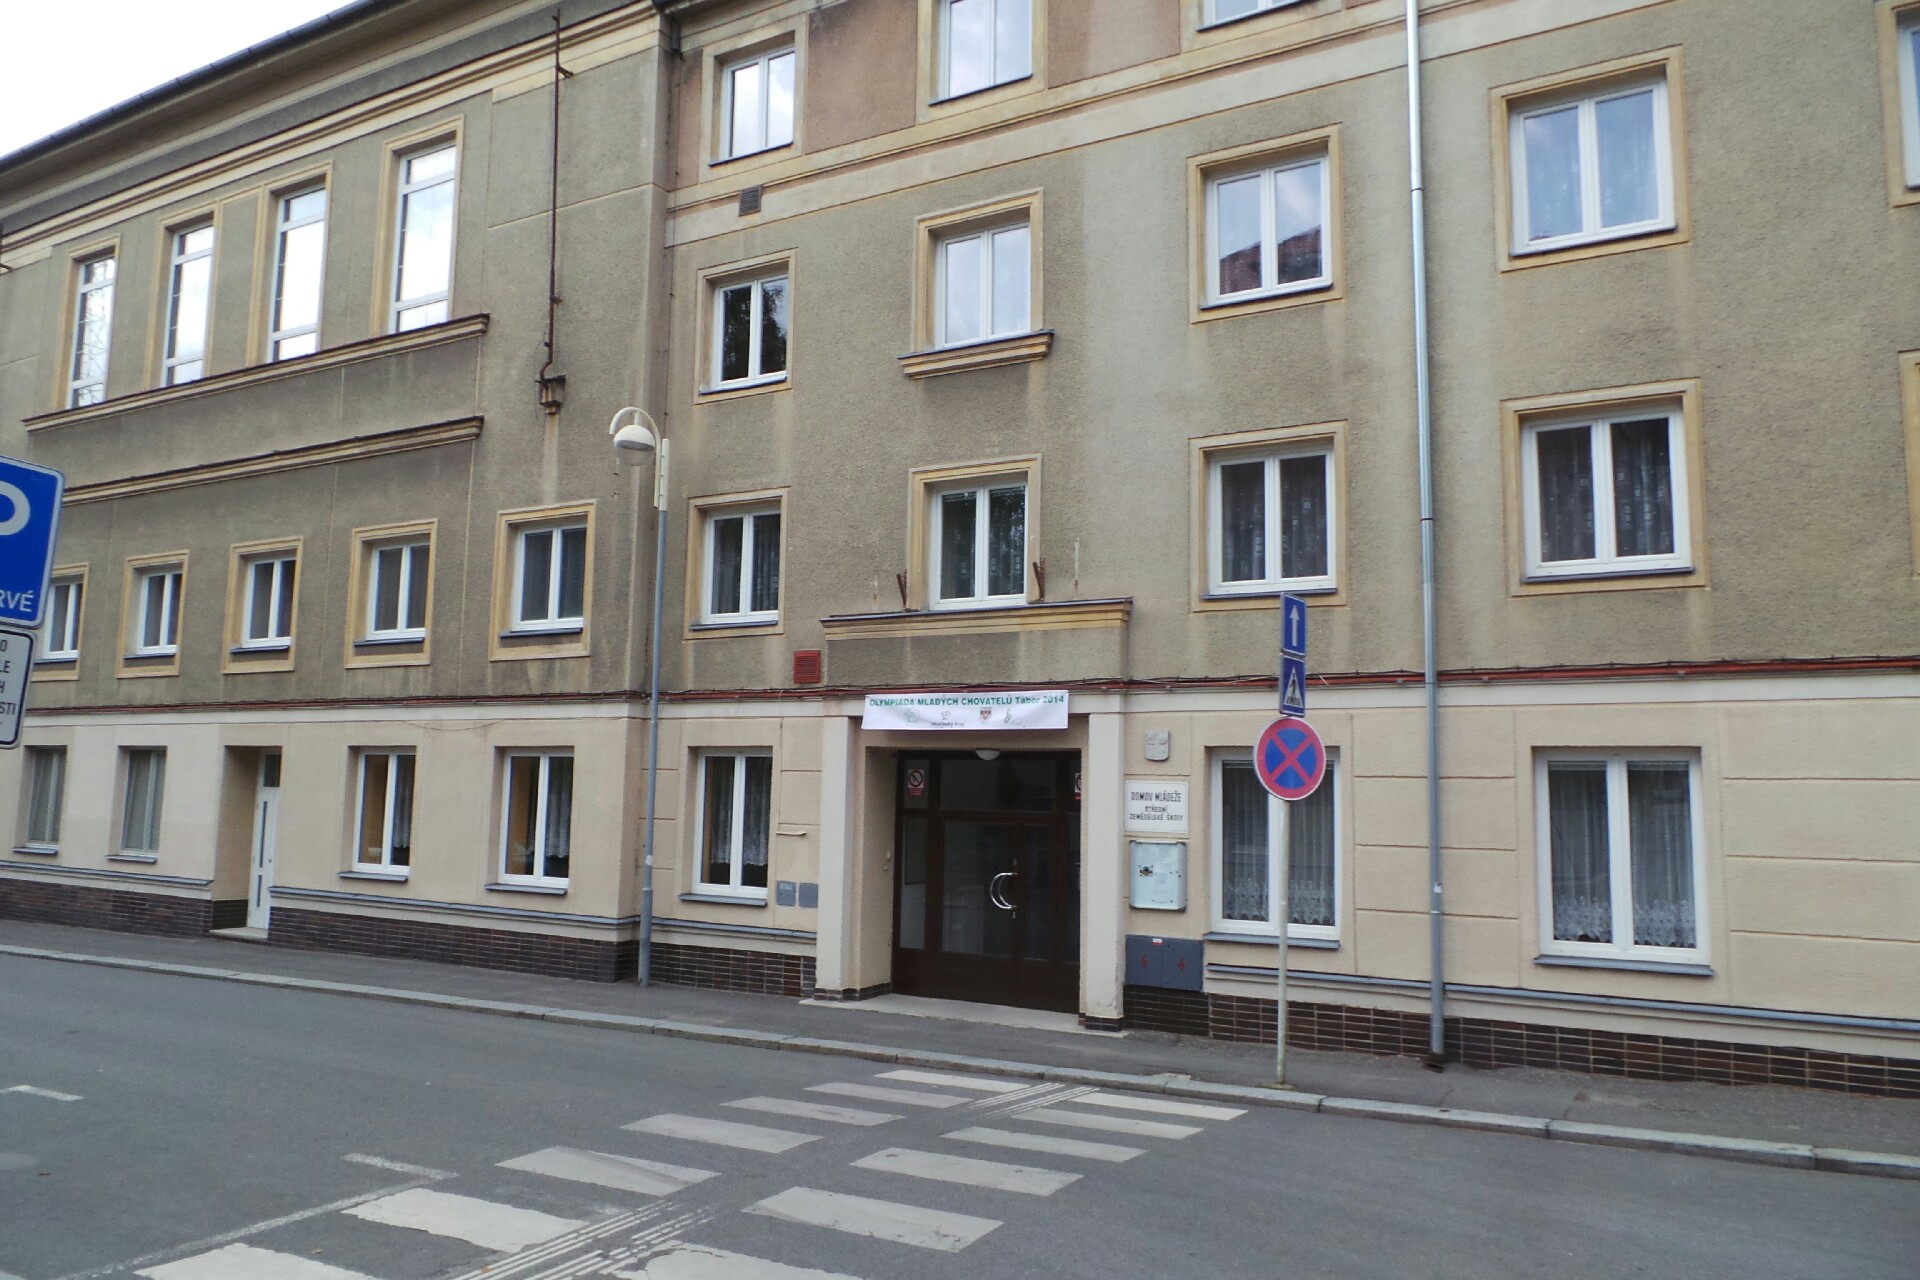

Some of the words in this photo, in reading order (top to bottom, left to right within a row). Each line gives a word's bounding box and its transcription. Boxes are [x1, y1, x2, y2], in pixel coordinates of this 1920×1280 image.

[1042, 695, 1064, 704] 2014
[1132, 792, 1153, 801] DOMOV
[1154, 790, 1182, 802] MLÁDEŽE
